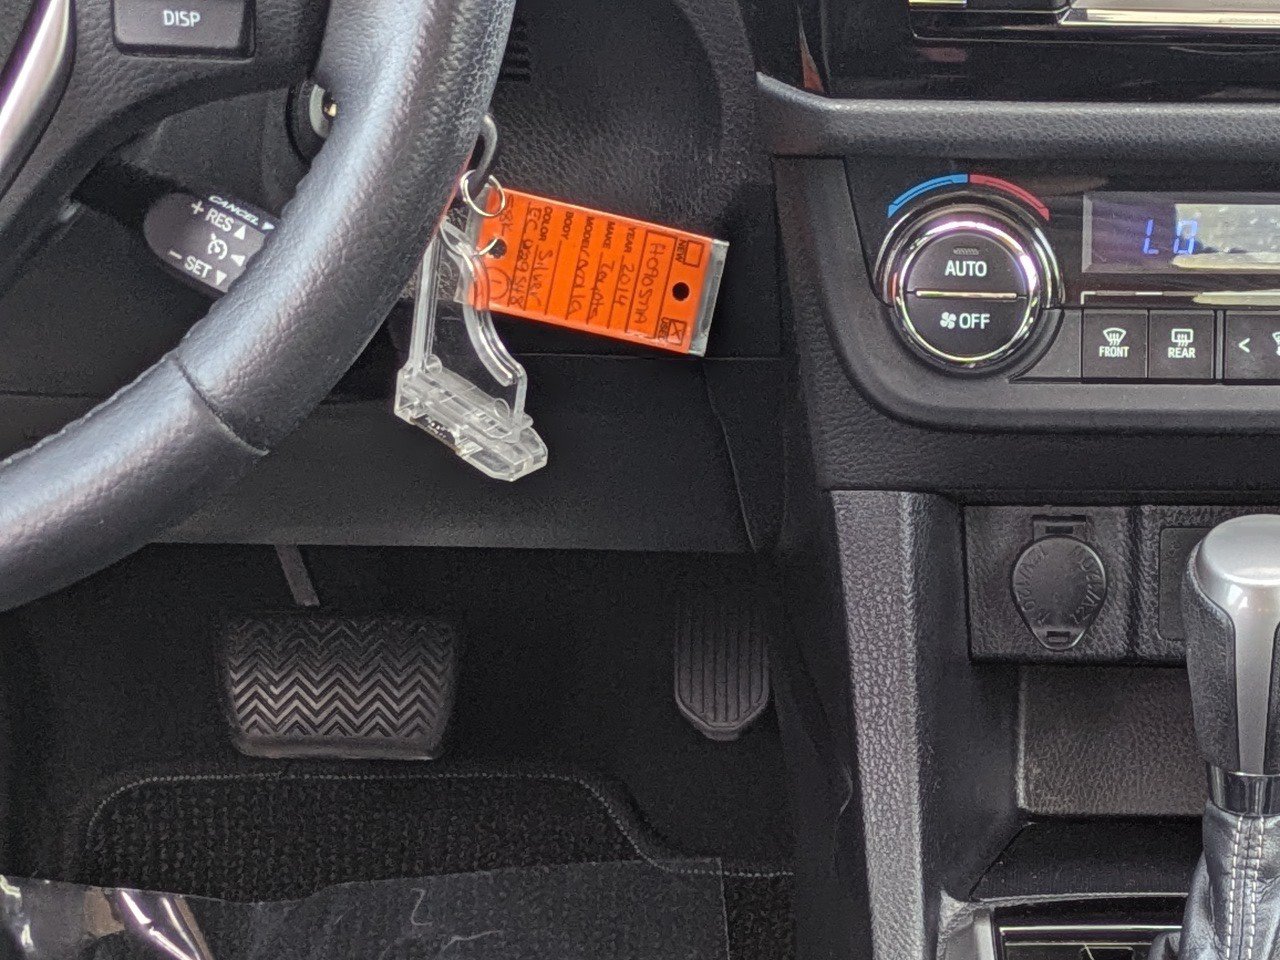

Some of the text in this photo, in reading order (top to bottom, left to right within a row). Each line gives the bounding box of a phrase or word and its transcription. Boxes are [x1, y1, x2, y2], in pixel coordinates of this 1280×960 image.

[163, 9, 201, 28] DISP
[205, 207, 235, 233] RES
[208, 194, 260, 226] CANCEL
[538, 205, 554, 242] COLOR
[562, 210, 575, 241] BODY
[602, 220, 617, 250] MAKE
[623, 226, 637, 254] YEAR
[674, 238, 688, 264] NEW
[183, 255, 213, 280] SET
[944, 260, 988, 278] AUTO
[615, 262, 635, 307] 2014
[958, 313, 991, 330] OFF
[1098, 345, 1130, 359] FRONT
[1167, 346, 1197, 359] REAR
